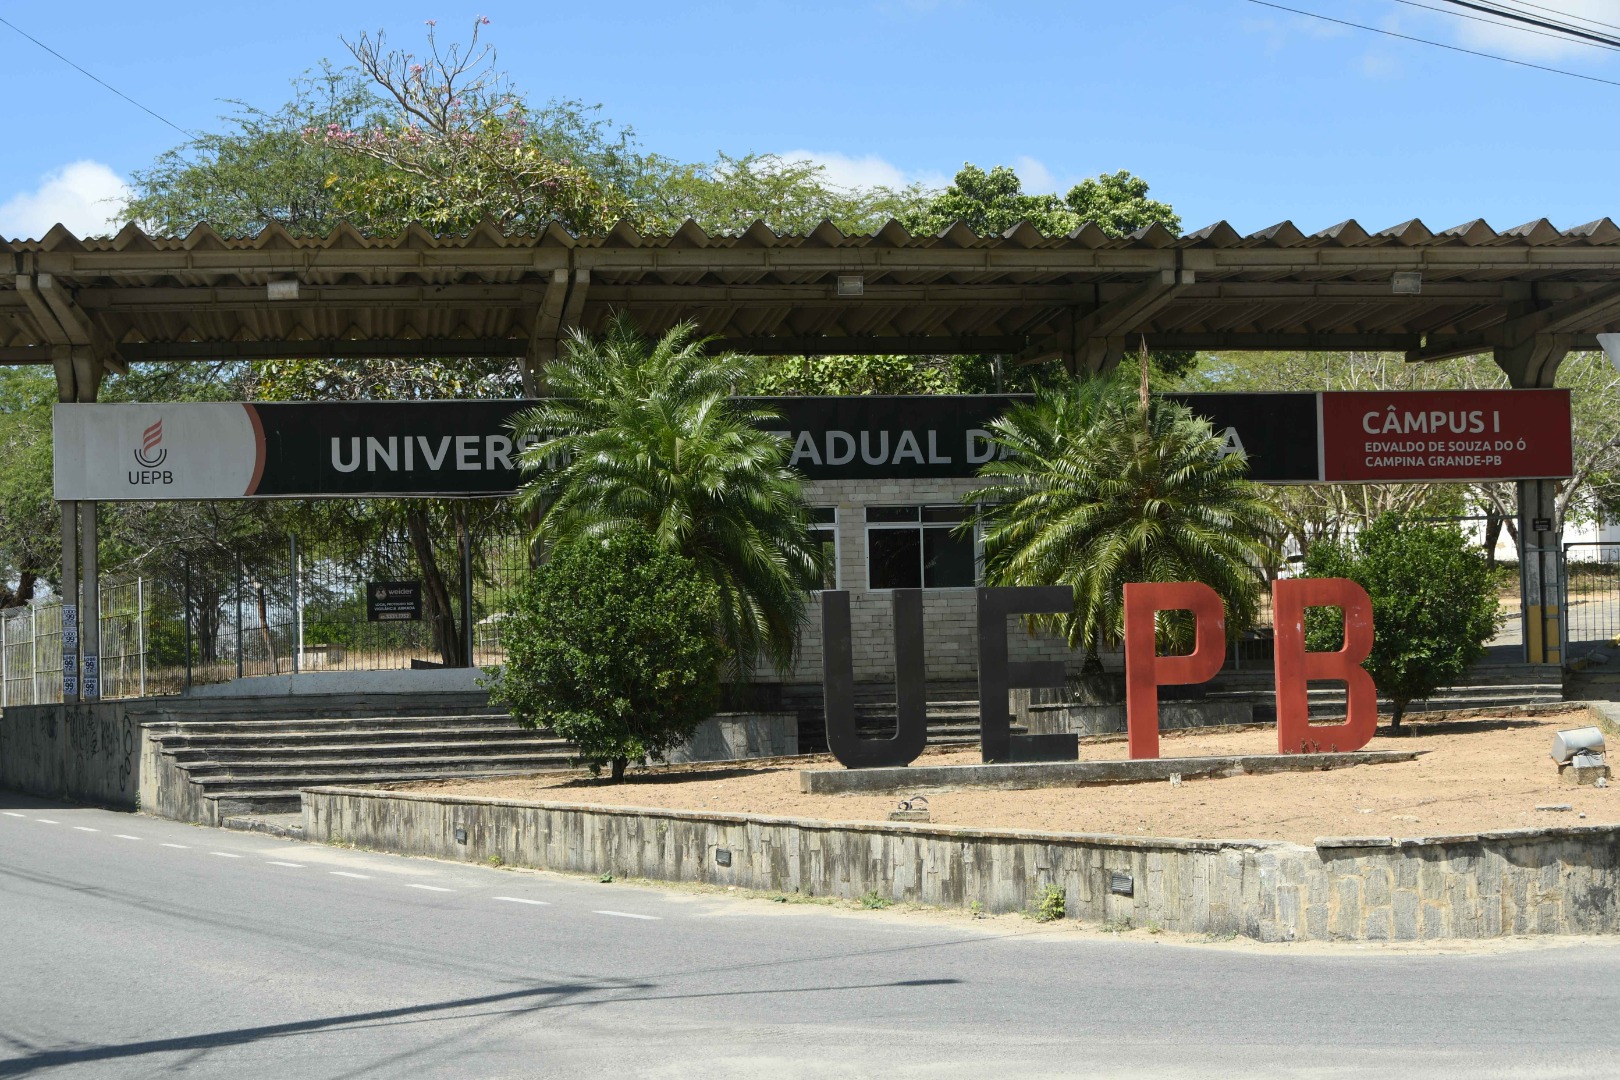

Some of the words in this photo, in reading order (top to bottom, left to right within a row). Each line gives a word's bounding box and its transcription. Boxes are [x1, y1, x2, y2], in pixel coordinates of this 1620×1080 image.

[1362, 404, 1485, 434] CÂMPUS
[1493, 410, 1501, 433] I
[766, 430, 952, 465] ADUAL
[1365, 441, 1425, 453] EDVALDO
[1428, 441, 1445, 452] DE
[1448, 441, 1491, 452] SOUZA
[1494, 440, 1513, 451] DO
[1516, 437, 1526, 451] Ó
[1365, 456, 1425, 467] CAMPINA
[1428, 455, 1502, 466] GRANDE-PB
[128, 470, 173, 484] UEPB
[822, 577, 1379, 769] UEPB
